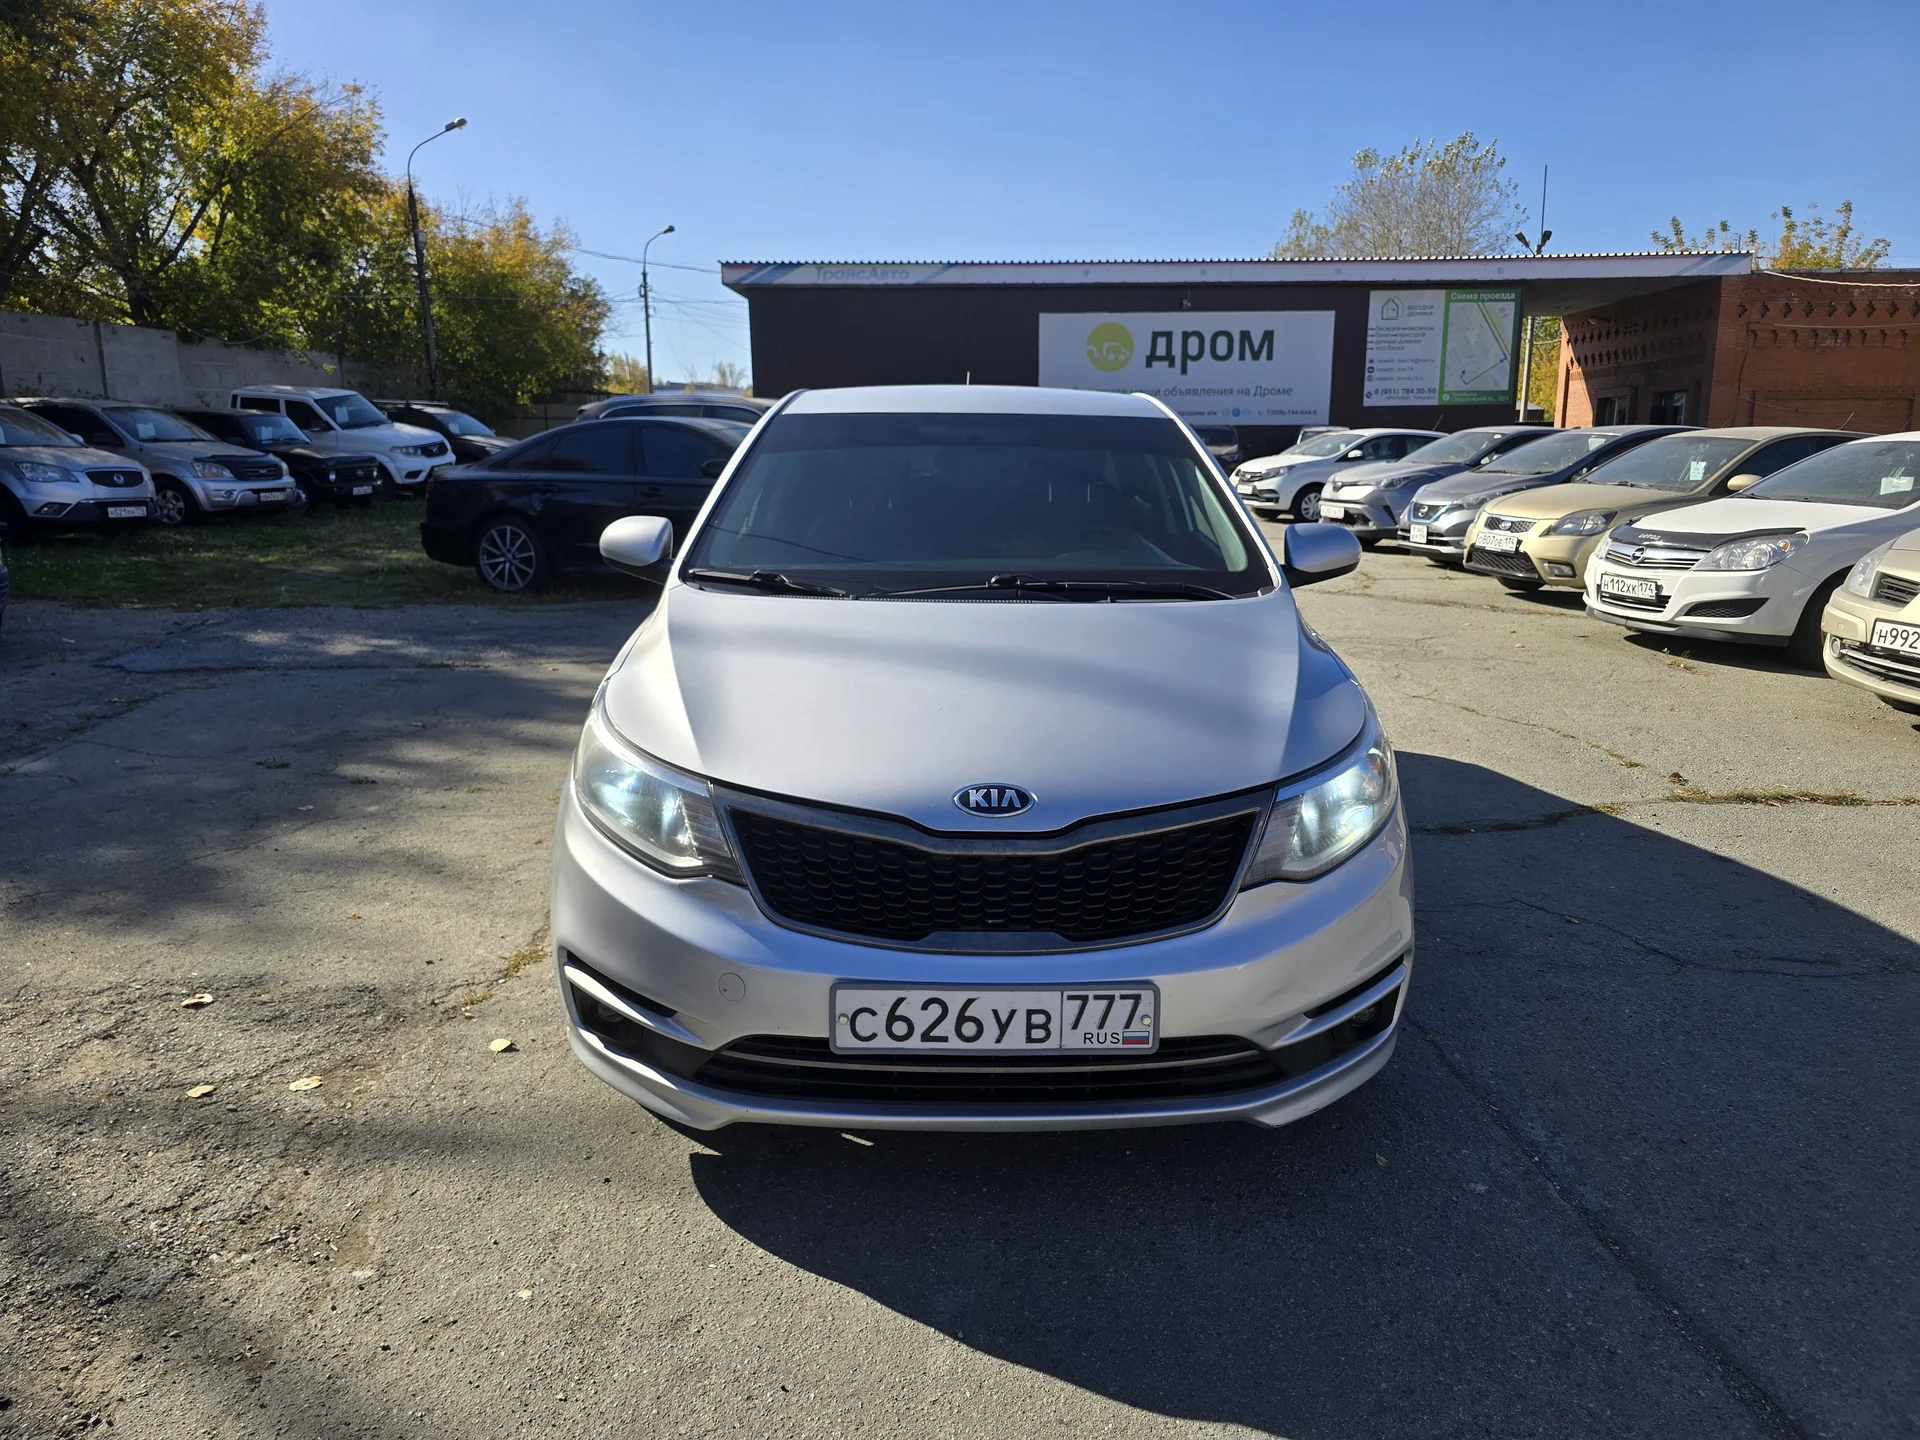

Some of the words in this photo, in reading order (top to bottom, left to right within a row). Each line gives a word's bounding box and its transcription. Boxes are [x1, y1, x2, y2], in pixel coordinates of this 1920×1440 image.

[1451, 292, 1478, 300] Схема
[1479, 292, 1515, 301] проезда
[1145, 330, 1274, 375] дром
[1164, 385, 1233, 397] объявления
[1237, 387, 1250, 397] на
[1253, 385, 1293, 398] Дроме
[1640, 582, 1653, 594] 174
[1877, 627, 1920, 650] Н992
[968, 788, 1021, 808] KIA
[849, 996, 1052, 1044] С626УВ
[1066, 994, 1142, 1030] 777
[1083, 1031, 1120, 1045] RUS
